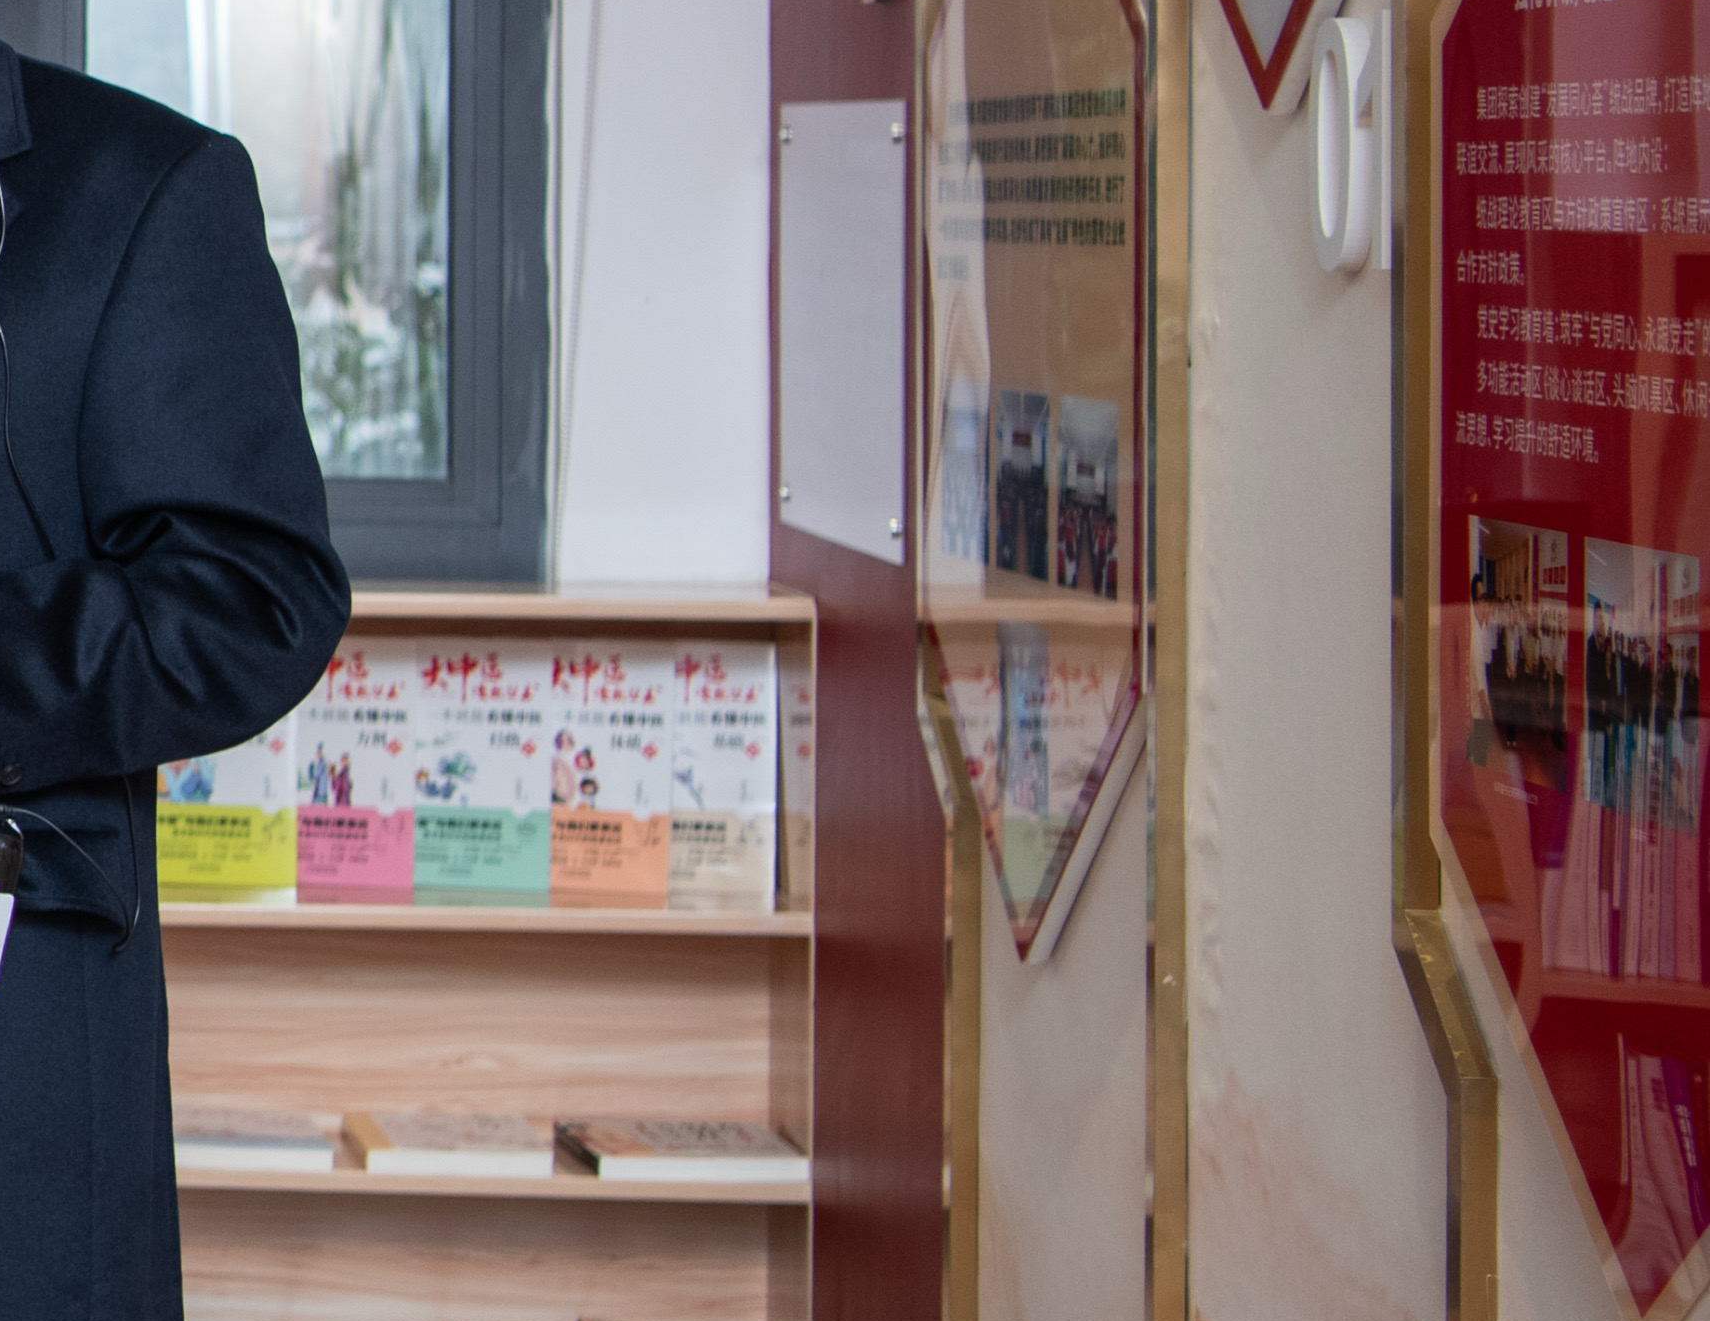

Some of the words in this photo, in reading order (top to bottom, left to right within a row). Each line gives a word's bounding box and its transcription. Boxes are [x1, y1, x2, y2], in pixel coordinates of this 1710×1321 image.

[1309, 8, 1391, 273] 01
[1456, 249, 1525, 286] 合作方针政策。
